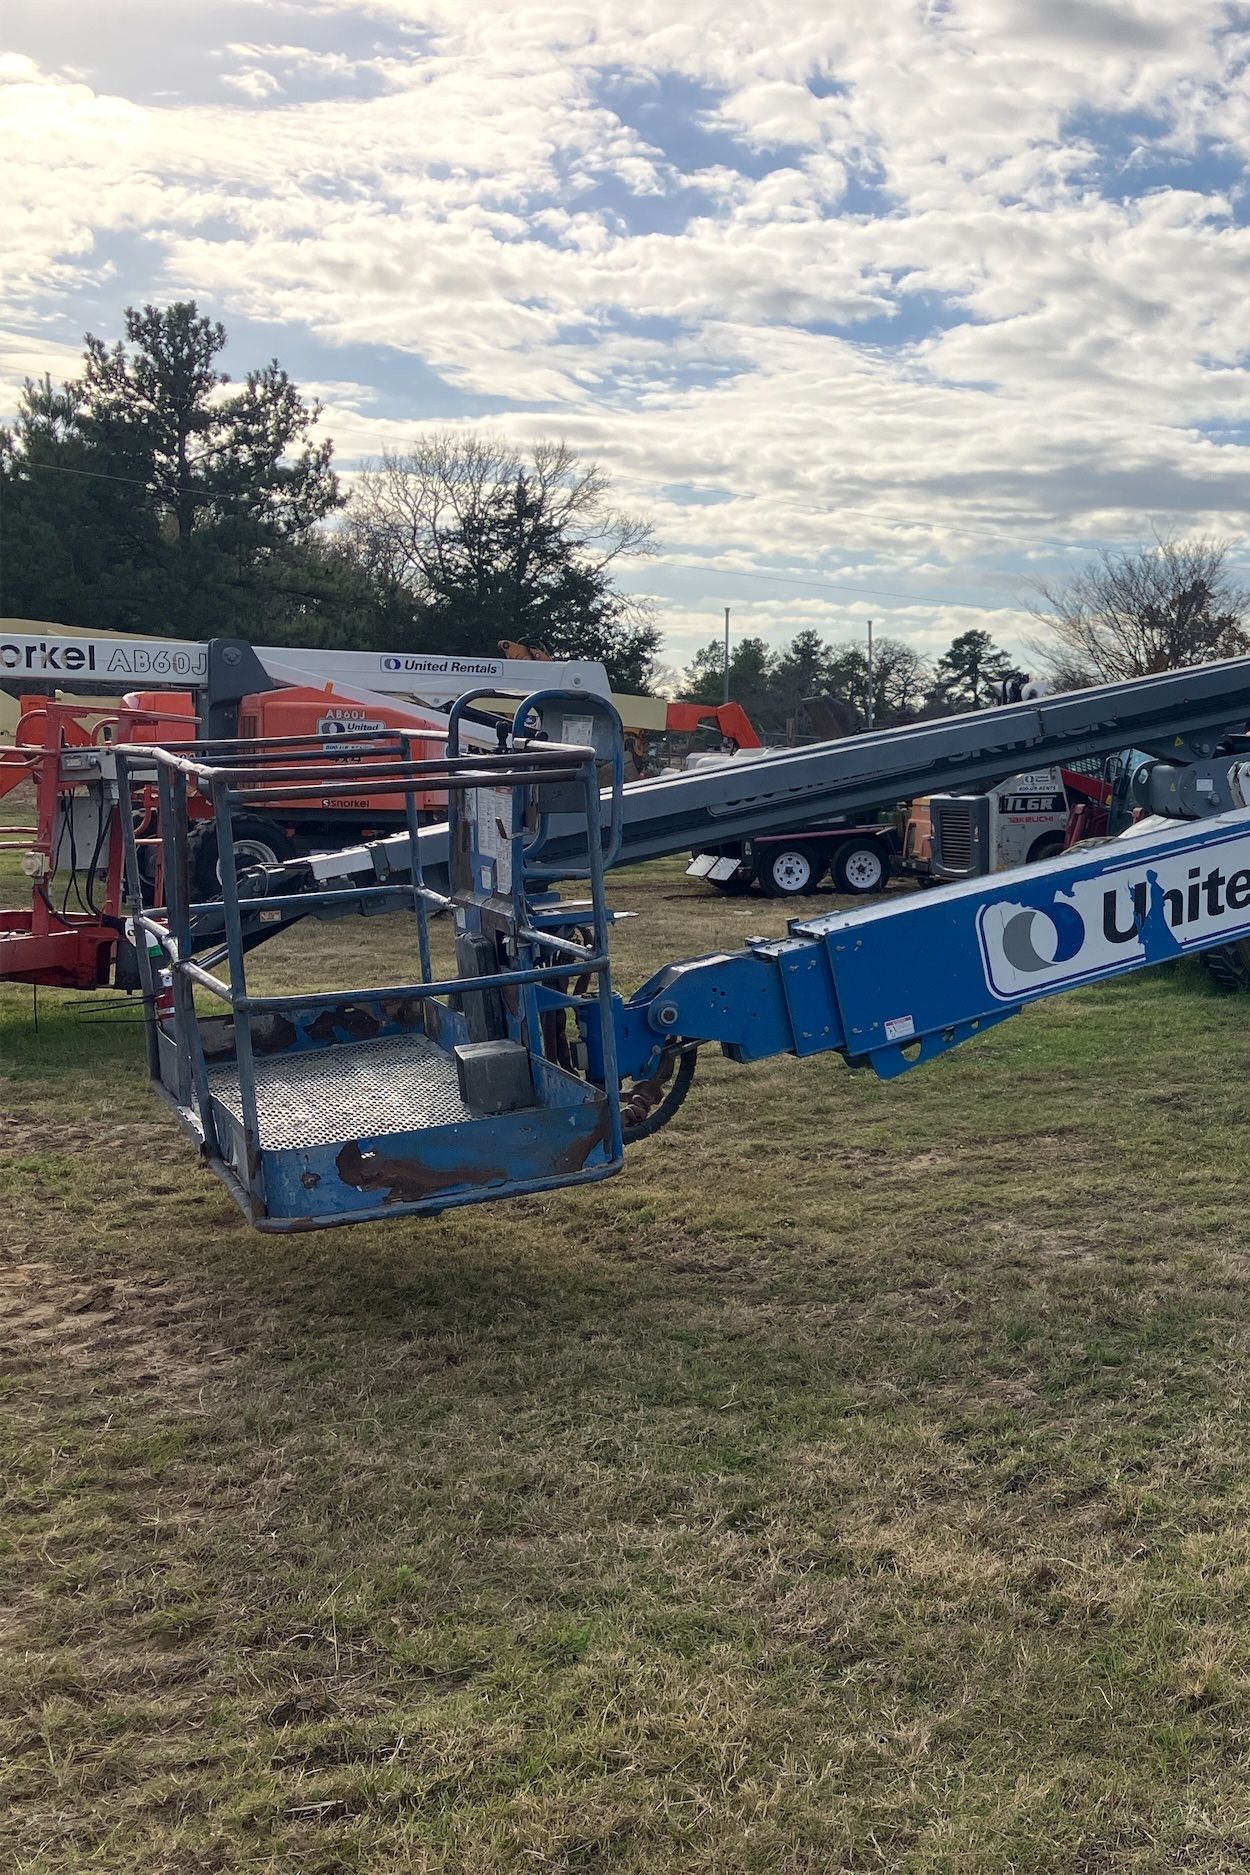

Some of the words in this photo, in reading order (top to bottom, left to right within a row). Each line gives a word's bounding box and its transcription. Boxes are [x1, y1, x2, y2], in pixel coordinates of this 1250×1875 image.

[107, 649, 208, 675] AB60J
[404, 660, 448, 671] United
[451, 662, 497, 674] Rentals
[326, 709, 366, 719] AB60J
[347, 723, 379, 731] United
[331, 800, 370, 808] snorkel
